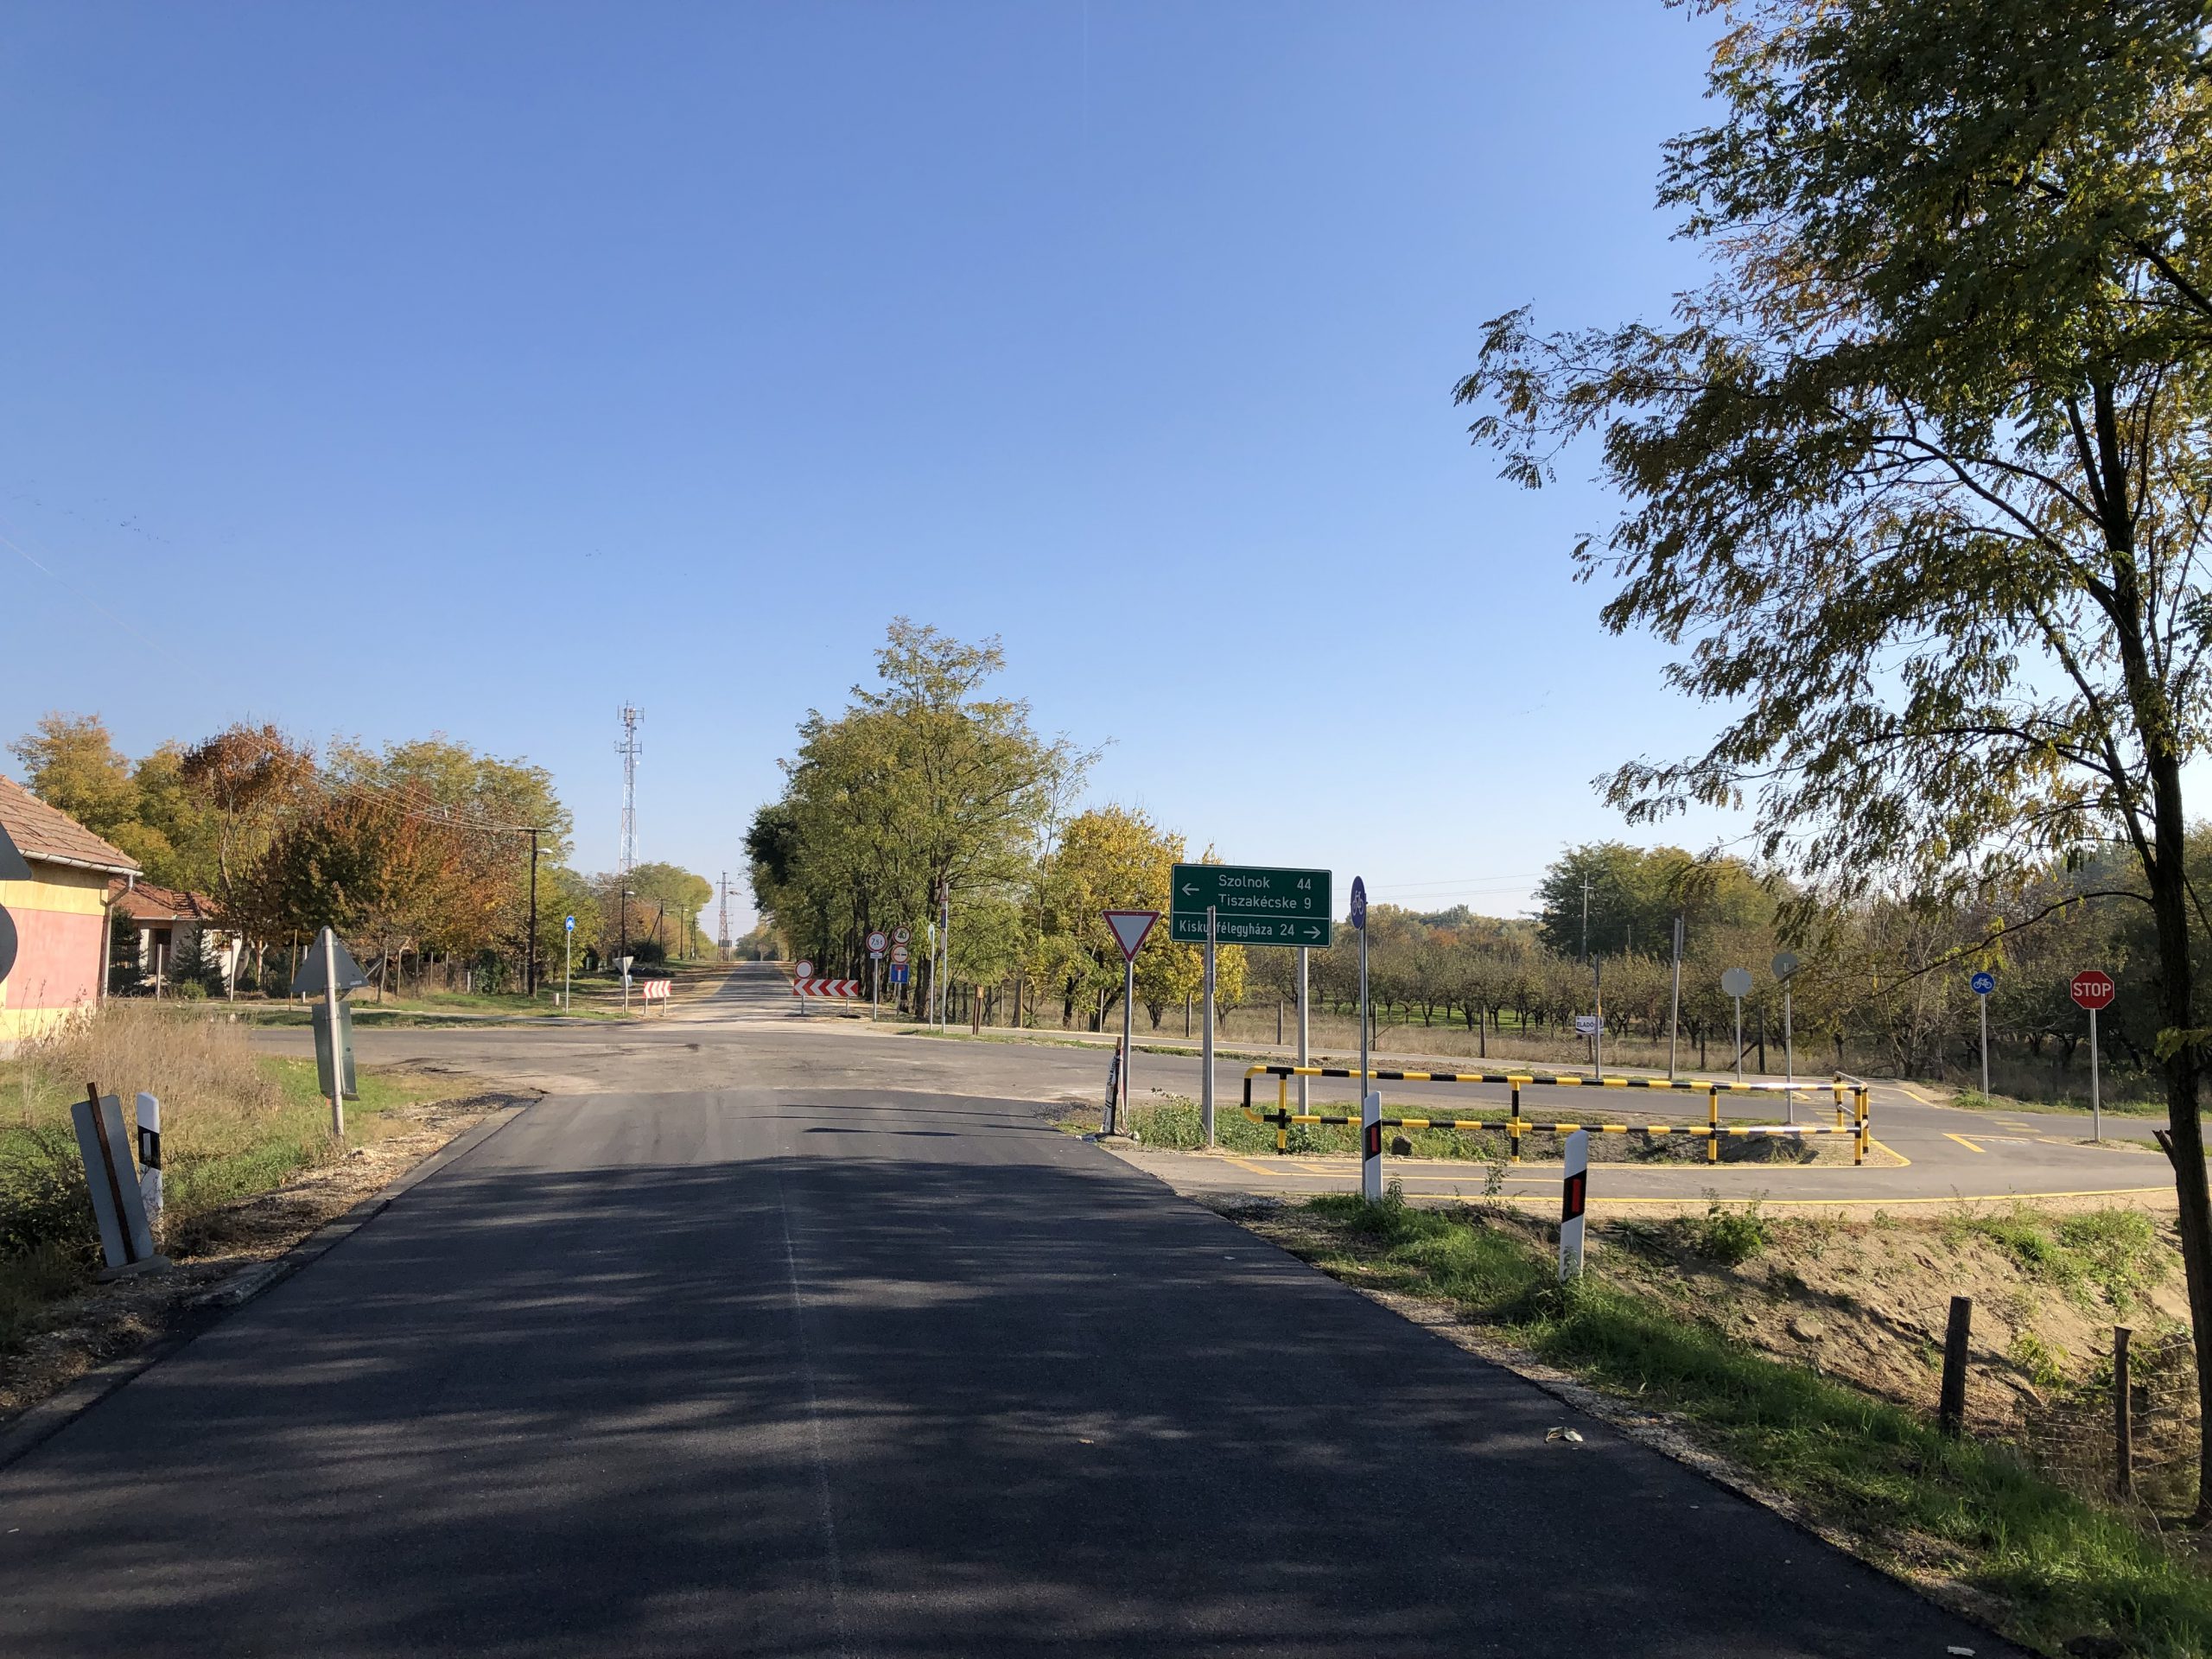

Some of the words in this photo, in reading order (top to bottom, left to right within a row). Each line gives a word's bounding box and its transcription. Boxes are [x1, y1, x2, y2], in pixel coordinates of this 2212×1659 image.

[1218, 874, 1270, 888] Szolnok
[1297, 878, 1312, 890] 44
[1218, 893, 1297, 909] Tiszakécske
[1304, 897, 1312, 909] 9
[1179, 919, 1273, 938] Kiskufélegyháza
[1280, 924, 1295, 936] 24
[2073, 982, 2112, 997] STOP
